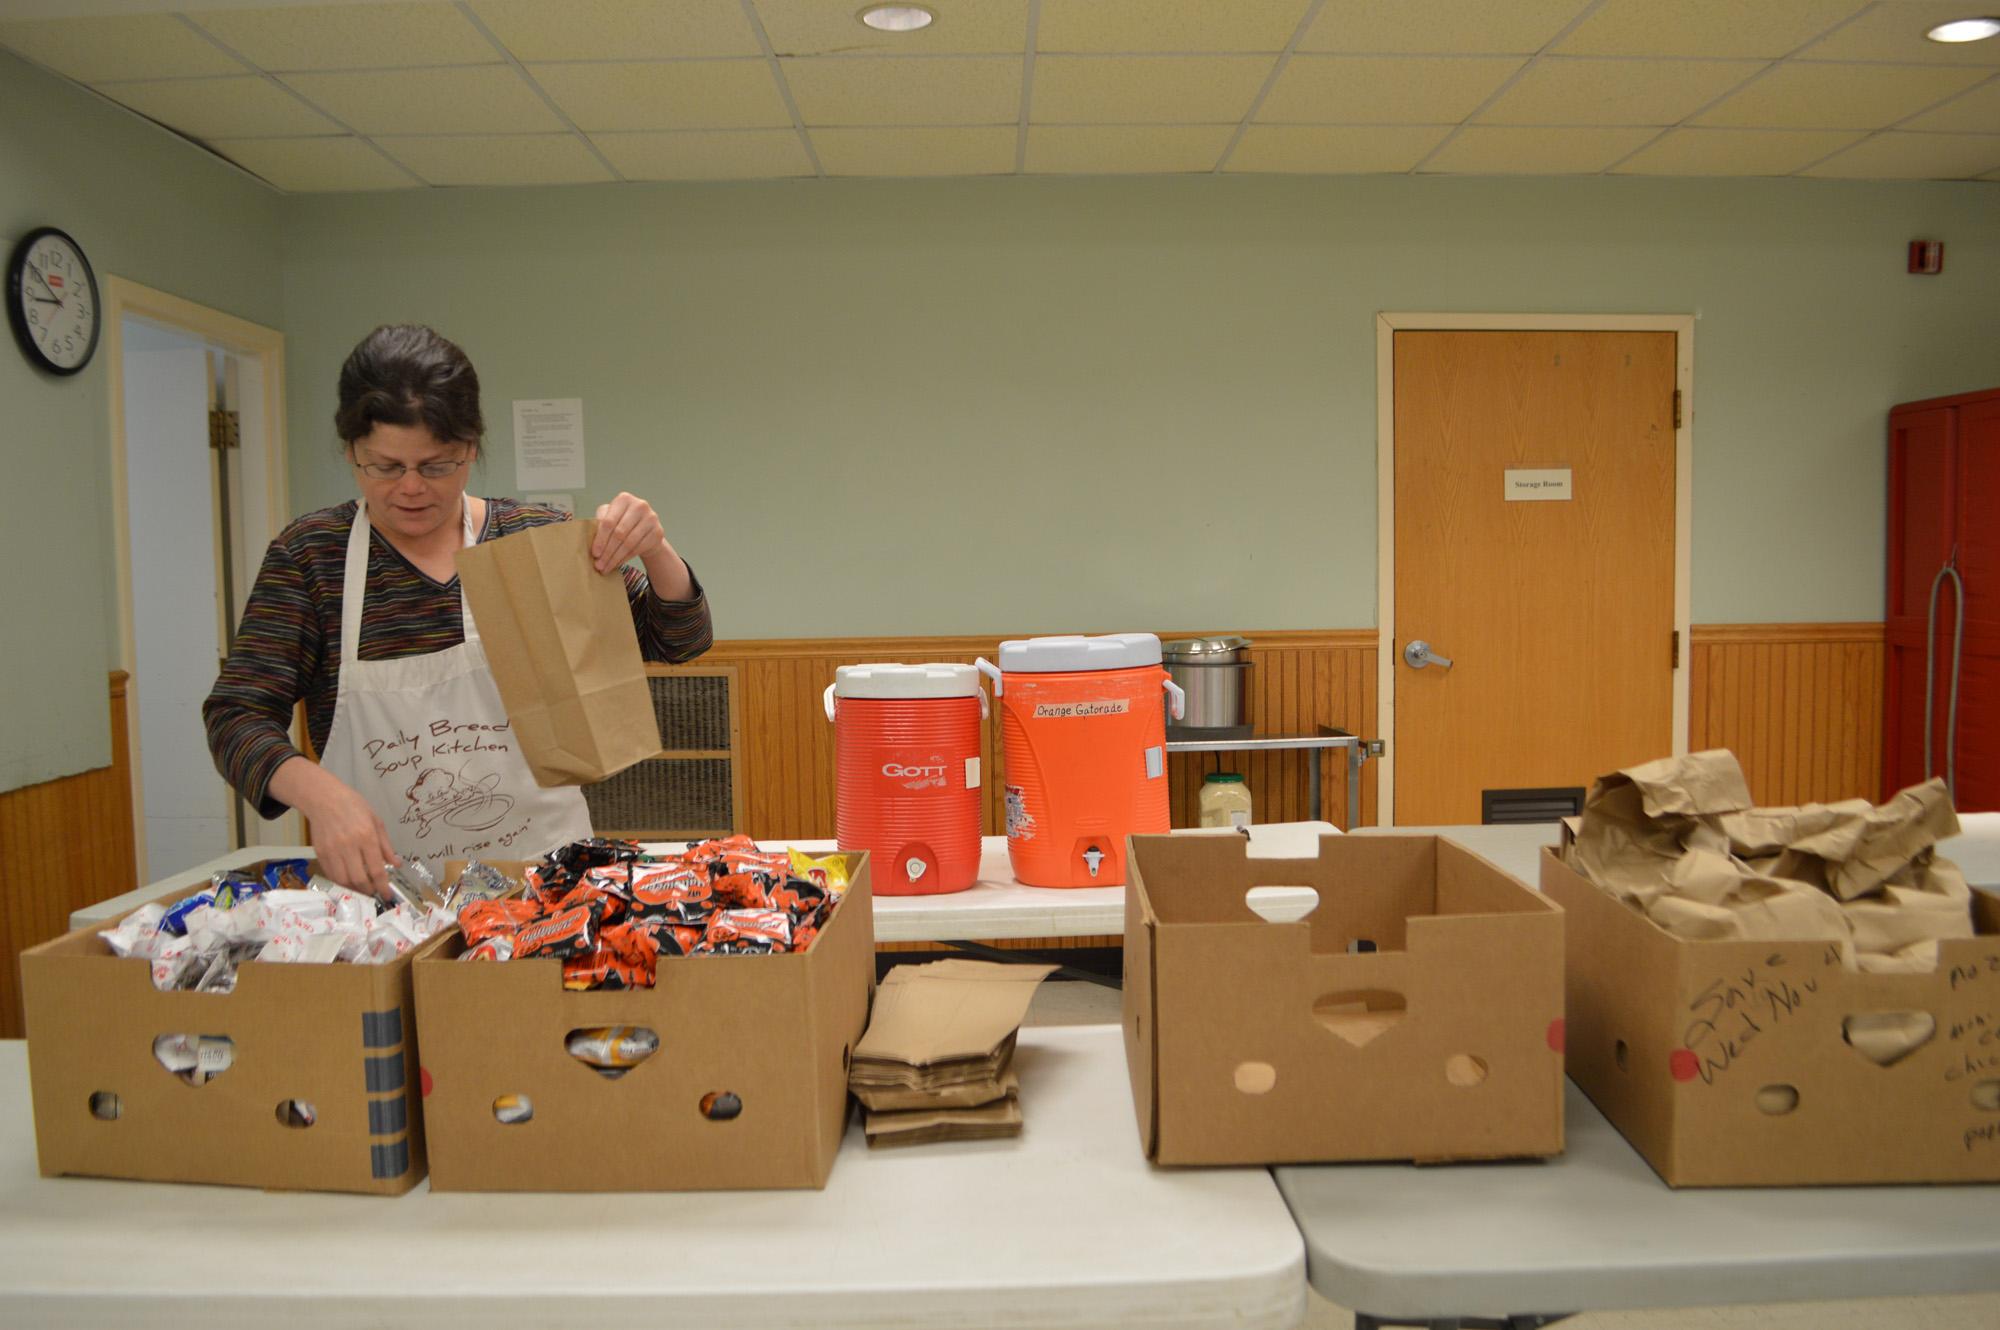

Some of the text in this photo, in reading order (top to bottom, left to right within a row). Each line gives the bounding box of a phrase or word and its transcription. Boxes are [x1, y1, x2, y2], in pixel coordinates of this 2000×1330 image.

[1514, 481, 1541, 489] Storage
[1037, 703, 1123, 717] Orange Gatorade
[363, 719, 510, 759] Daily Bread
[432, 735, 509, 757] Kitchen
[427, 844, 454, 860] will
[462, 841, 490, 854] rise
